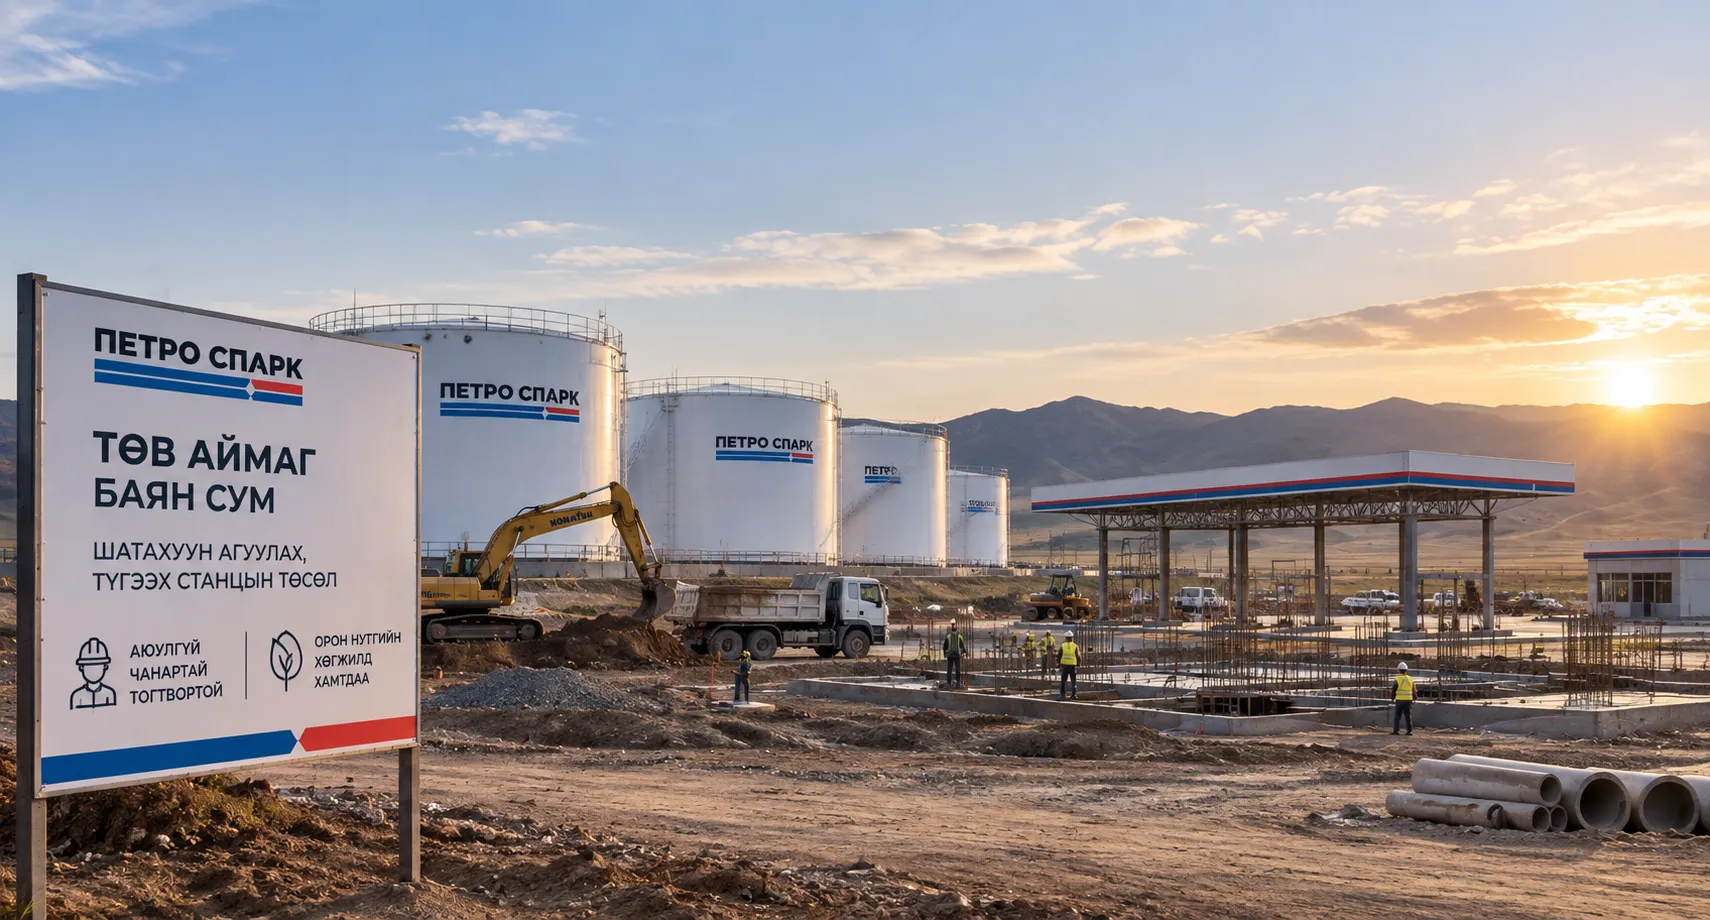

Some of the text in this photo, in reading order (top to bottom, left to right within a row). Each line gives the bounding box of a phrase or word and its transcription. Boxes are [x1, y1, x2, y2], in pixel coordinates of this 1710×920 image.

[94, 327, 304, 380] ПЕТРО СПАРК
[440, 382, 580, 406] ПЕТРО СПАРК
[93, 430, 317, 476] ТӨВ АЙМАГ
[715, 436, 814, 452] ПЕТРО СПАРК
[94, 477, 275, 514] БАЯН СУМ
[93, 541, 307, 564] ШАТАХУУН АГУУЛАХ,
[92, 571, 337, 593] ТҮГЭЭХ СТАНЦЫН ТӨСӨЛ
[129, 638, 201, 659] АЮУЛГҮЙ
[314, 629, 402, 648] ОРОН НУТГИЙН
[129, 660, 208, 682] ЧАНАРТАЙ
[314, 652, 373, 669] ХӨГЖИЛД
[314, 672, 370, 689] ХАМТДАА
[129, 681, 223, 705] ТОГТВОРТОЙ
